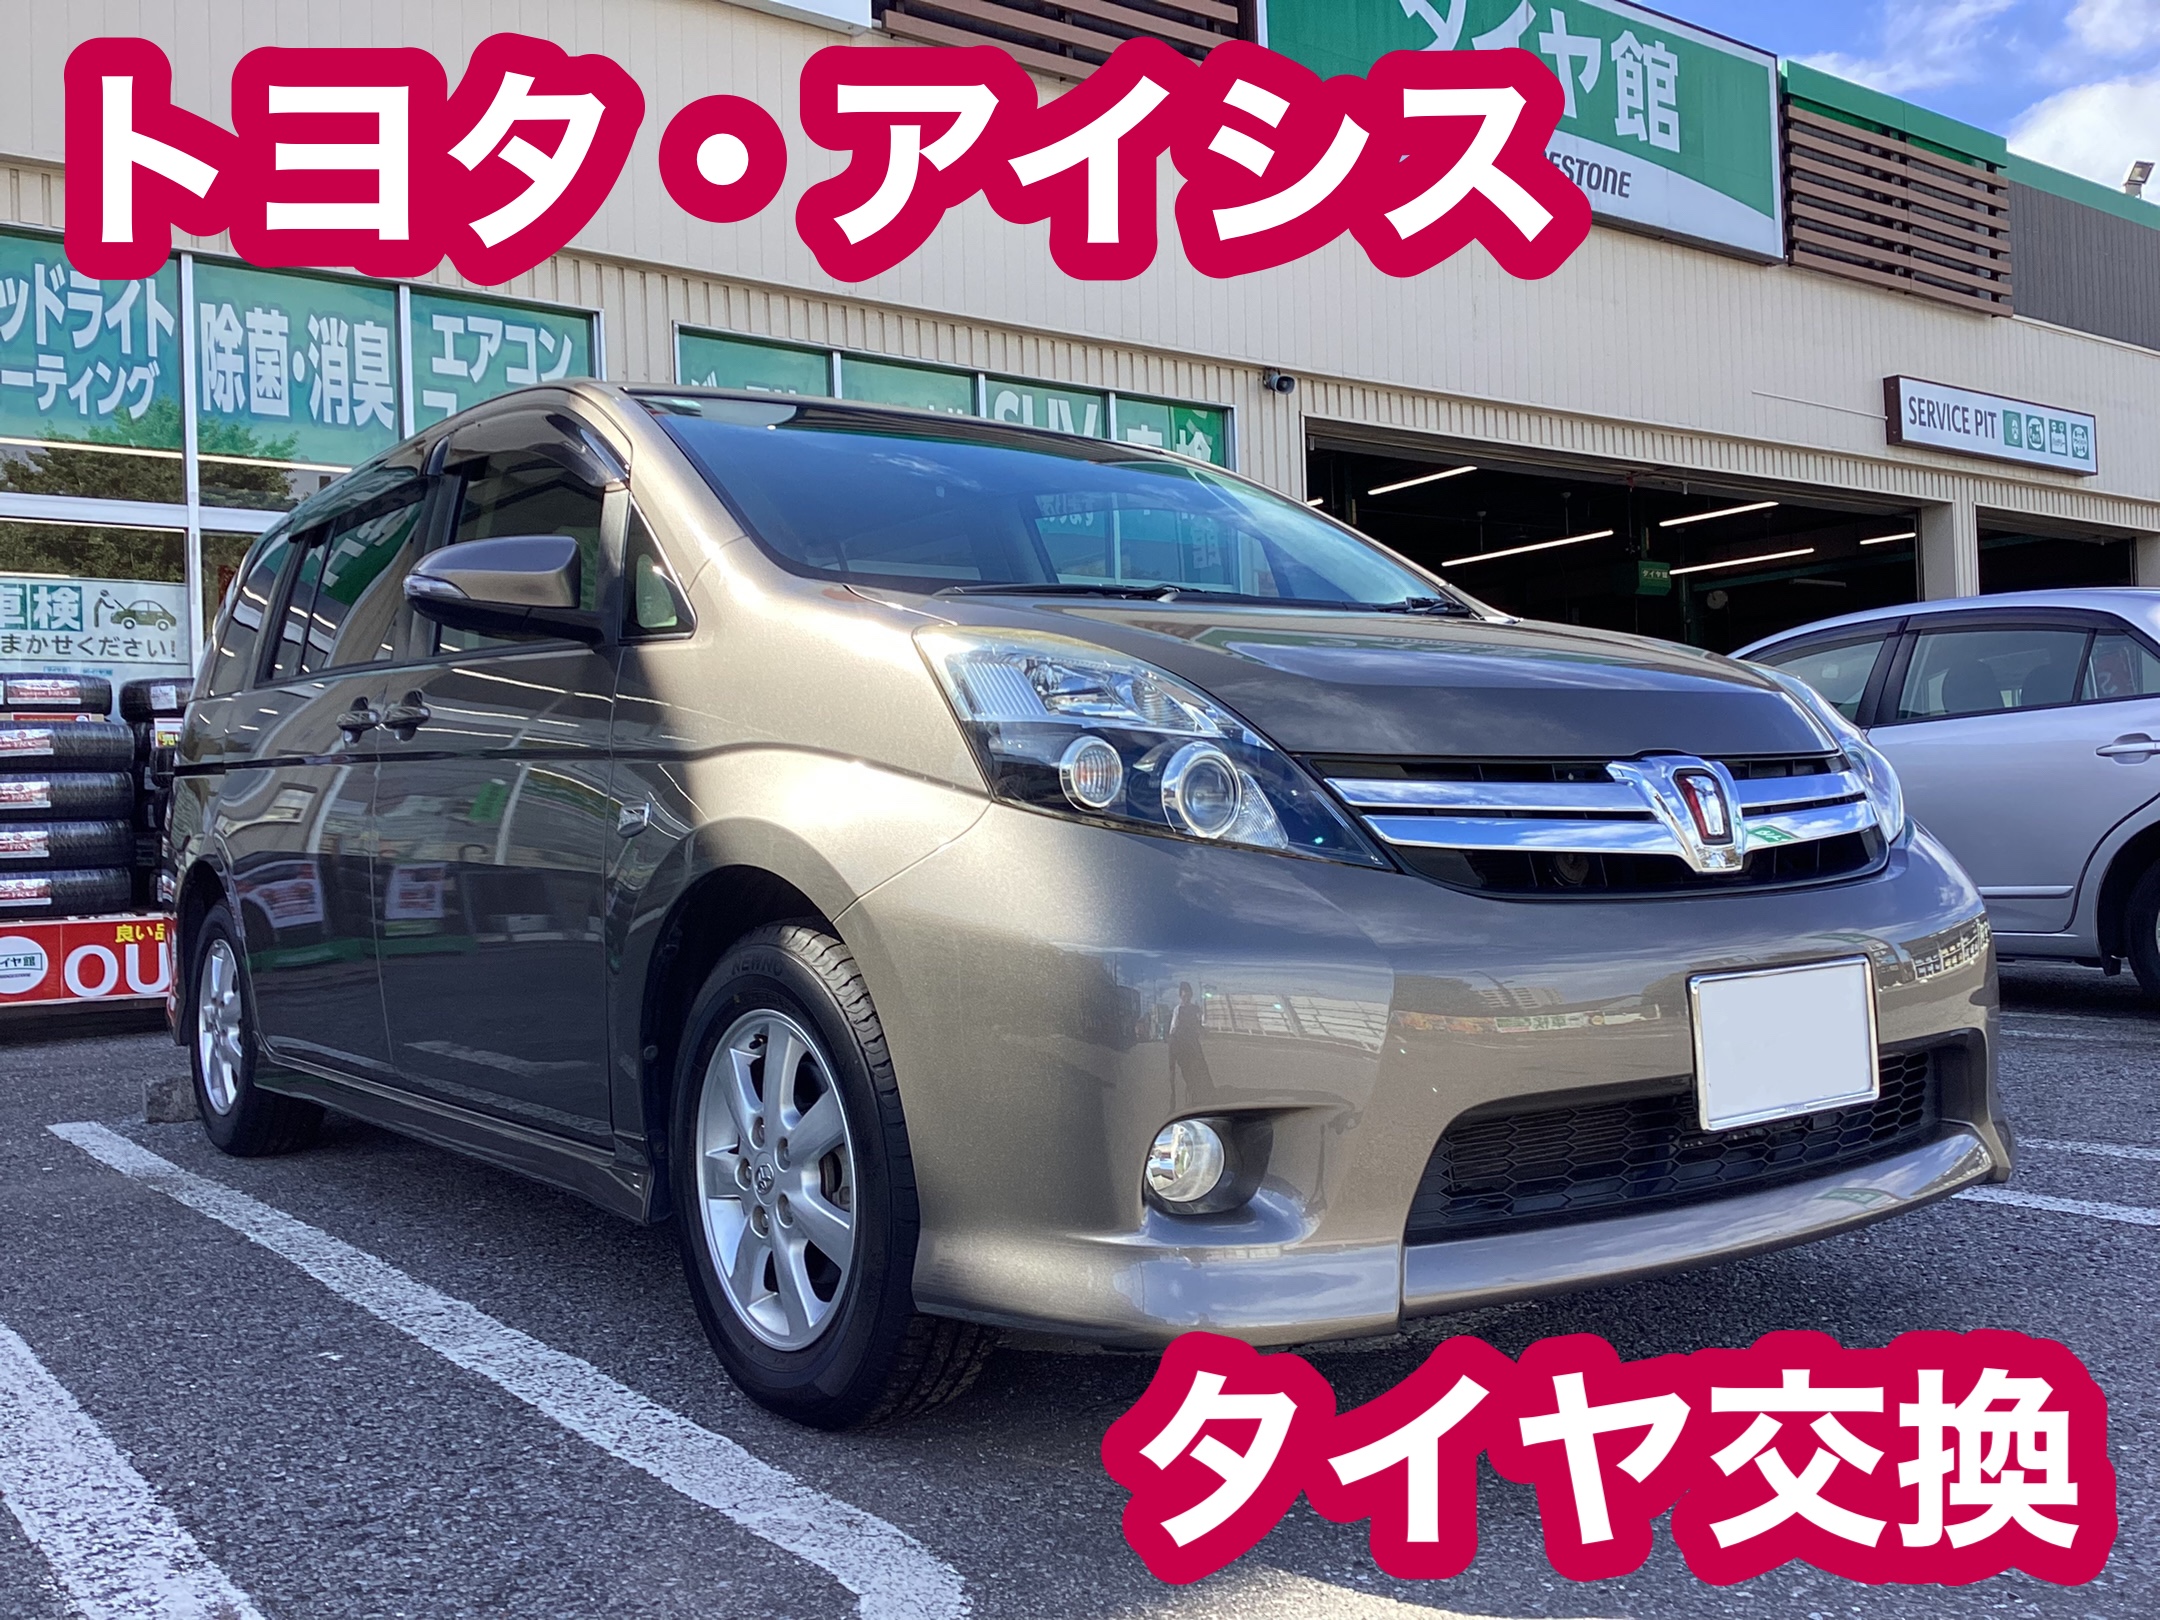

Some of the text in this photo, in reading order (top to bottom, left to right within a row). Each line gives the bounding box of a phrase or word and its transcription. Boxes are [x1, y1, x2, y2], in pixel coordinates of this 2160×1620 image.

[1543, 151, 1632, 198] ESTONE
[200, 303, 395, 430] 除菌・消臭
[432, 315, 572, 384] エアコン
[1908, 395, 1998, 439] SERVICE PIT
